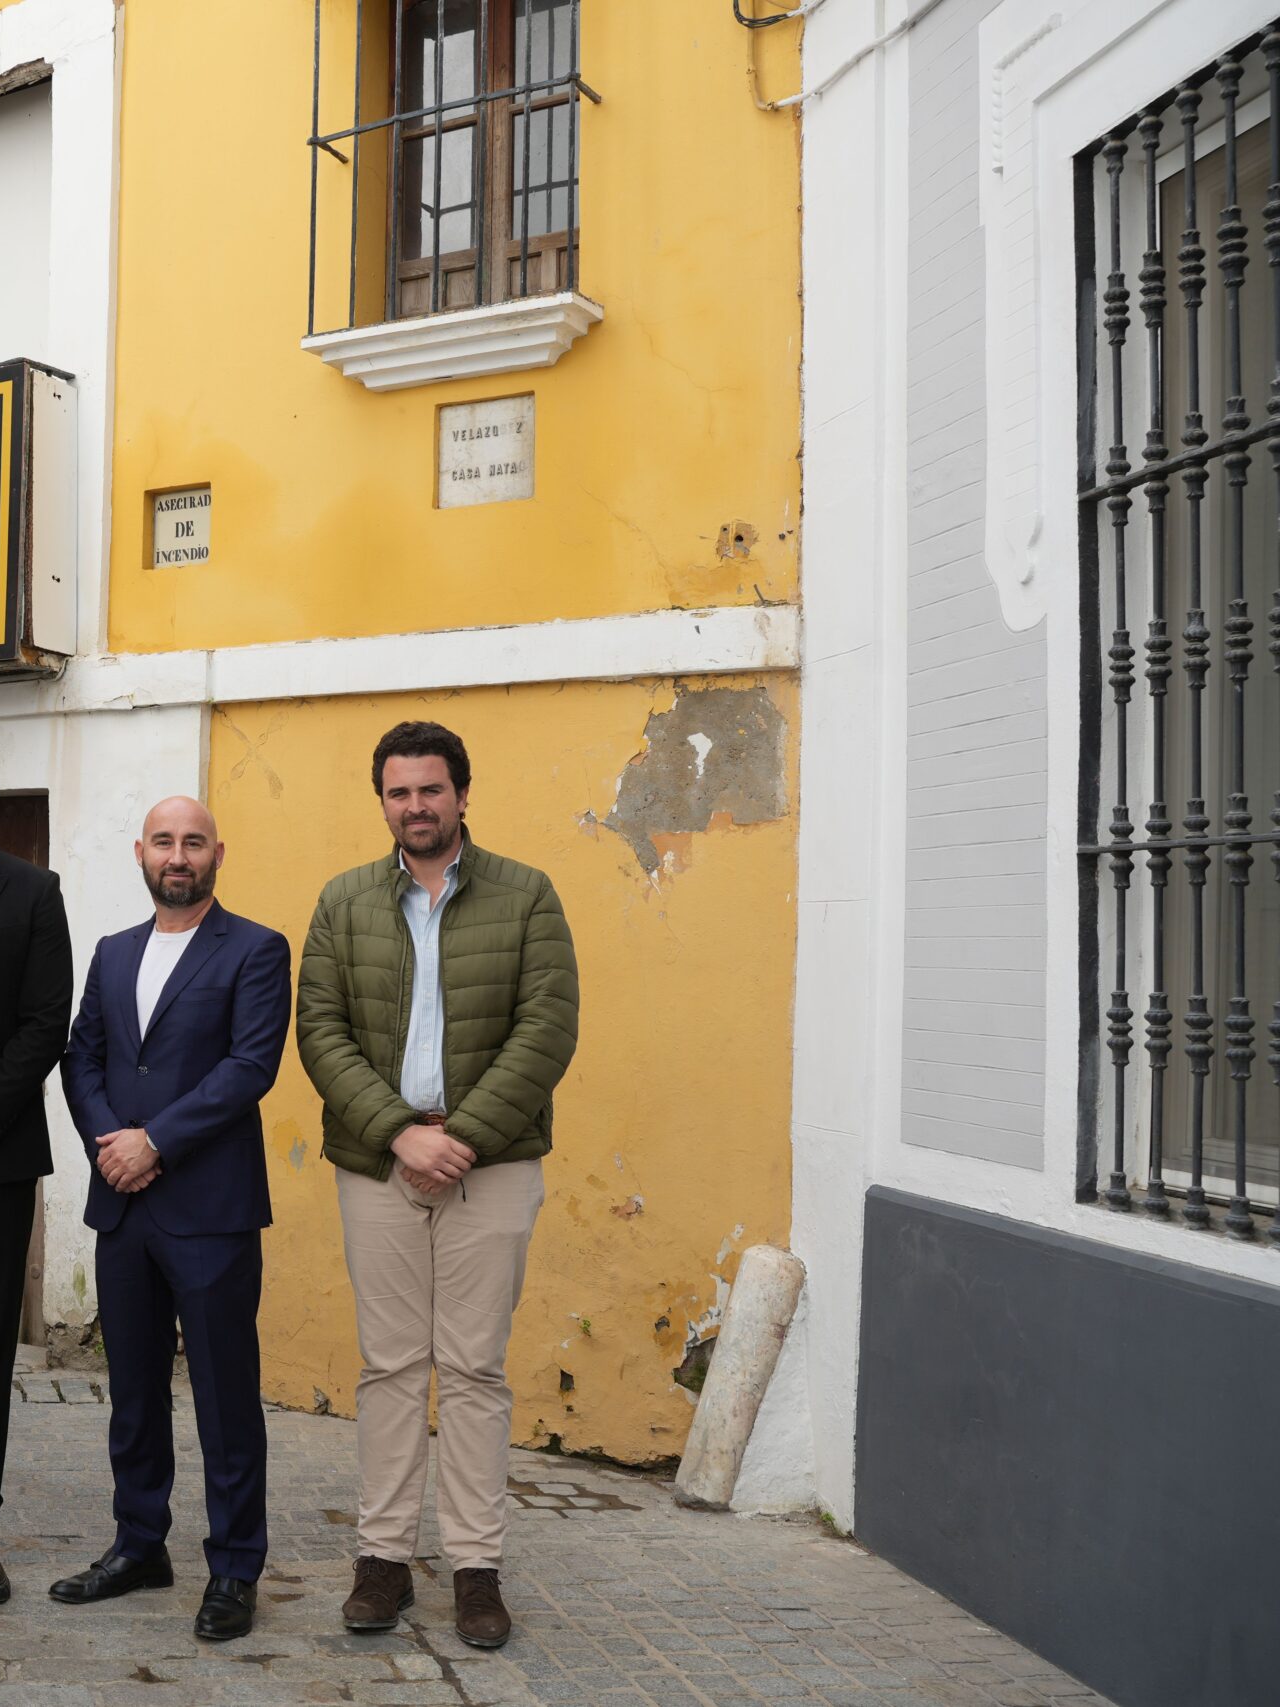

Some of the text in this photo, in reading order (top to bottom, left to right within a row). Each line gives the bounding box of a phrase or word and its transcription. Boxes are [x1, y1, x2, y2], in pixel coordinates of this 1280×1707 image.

[452, 421, 524, 441] VELAZQZ
[452, 467, 481, 481] CASA
[175, 520, 194, 538] DE
